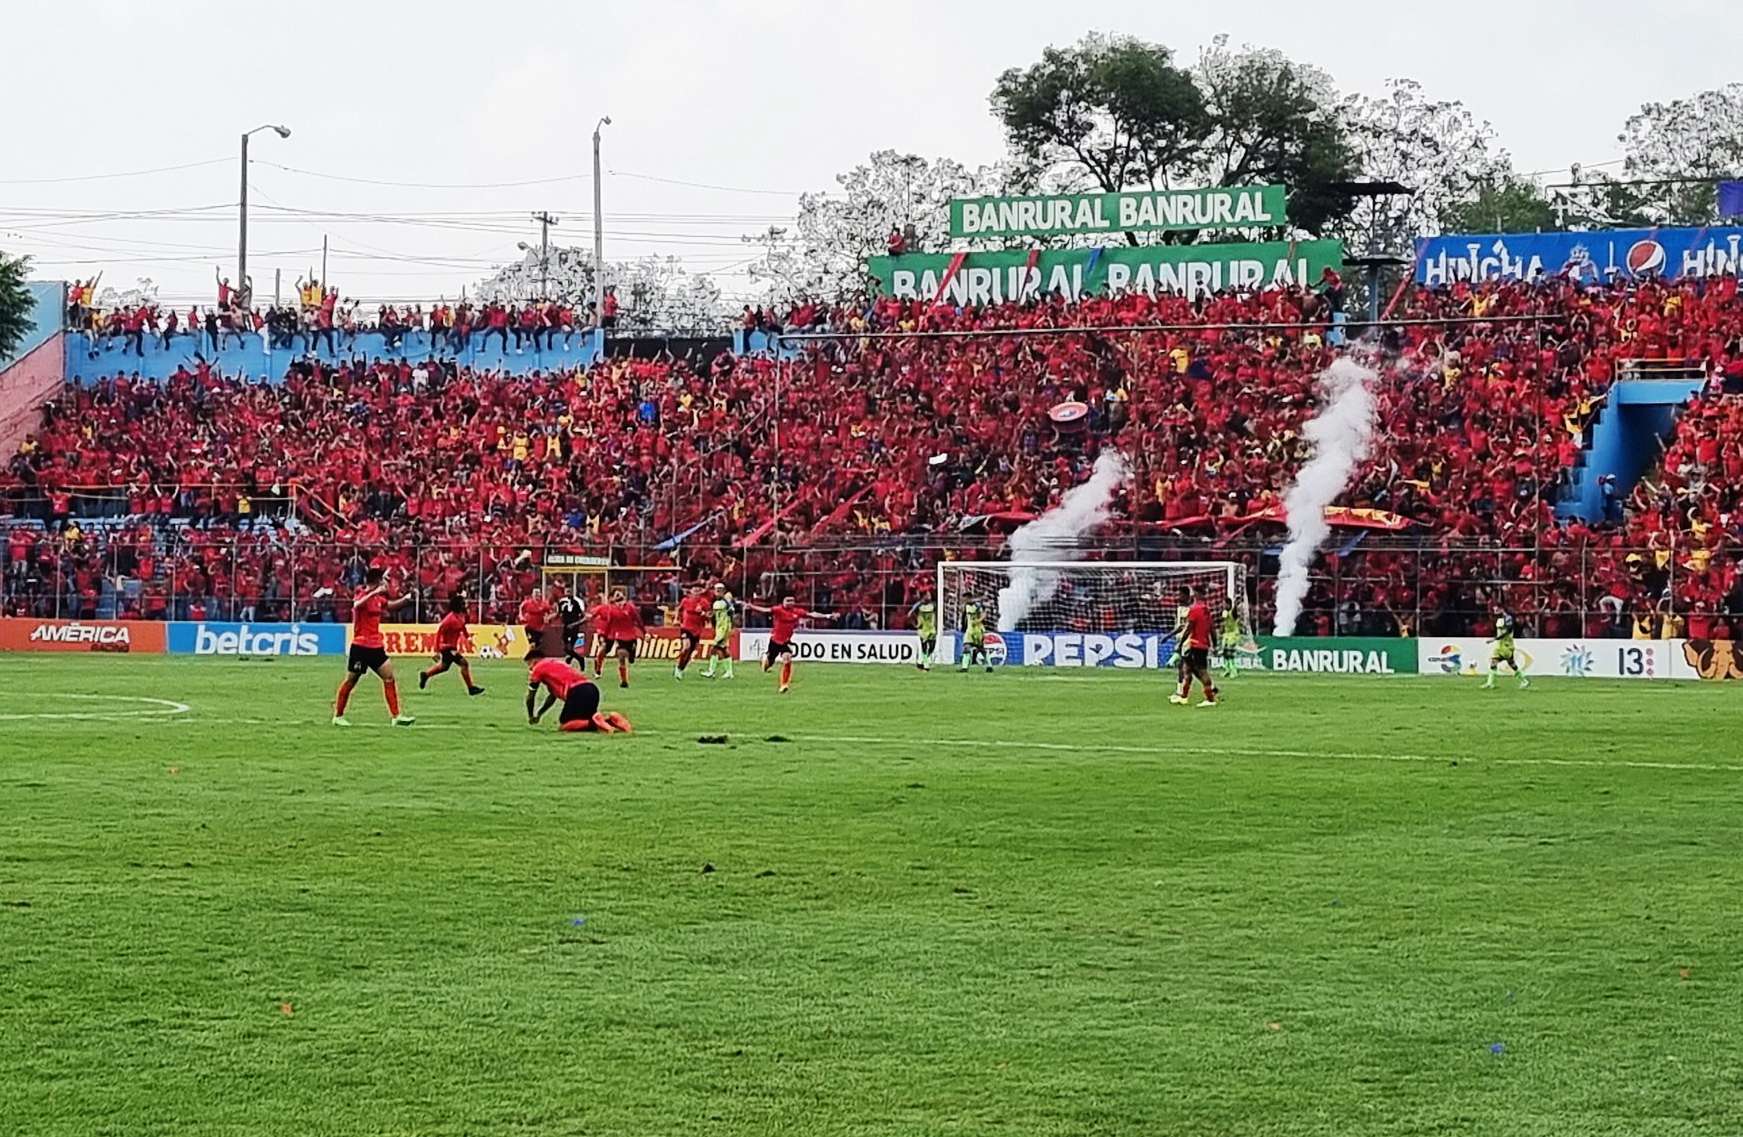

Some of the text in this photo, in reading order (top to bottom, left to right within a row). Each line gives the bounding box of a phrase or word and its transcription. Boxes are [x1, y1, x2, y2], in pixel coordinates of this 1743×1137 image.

[962, 190, 1272, 235] BANRURAL BANRURAL
[1425, 239, 1543, 286] HINCHA
[1683, 235, 1743, 277] HIN
[892, 263, 1086, 307] BANRURAL
[194, 624, 319, 655] betcris
[831, 643, 851, 659] EN
[857, 643, 913, 660] SALUD
[1023, 633, 1159, 668] PEPSI
[1272, 649, 1394, 674] BANRURAL
[1618, 647, 1644, 676] 13
